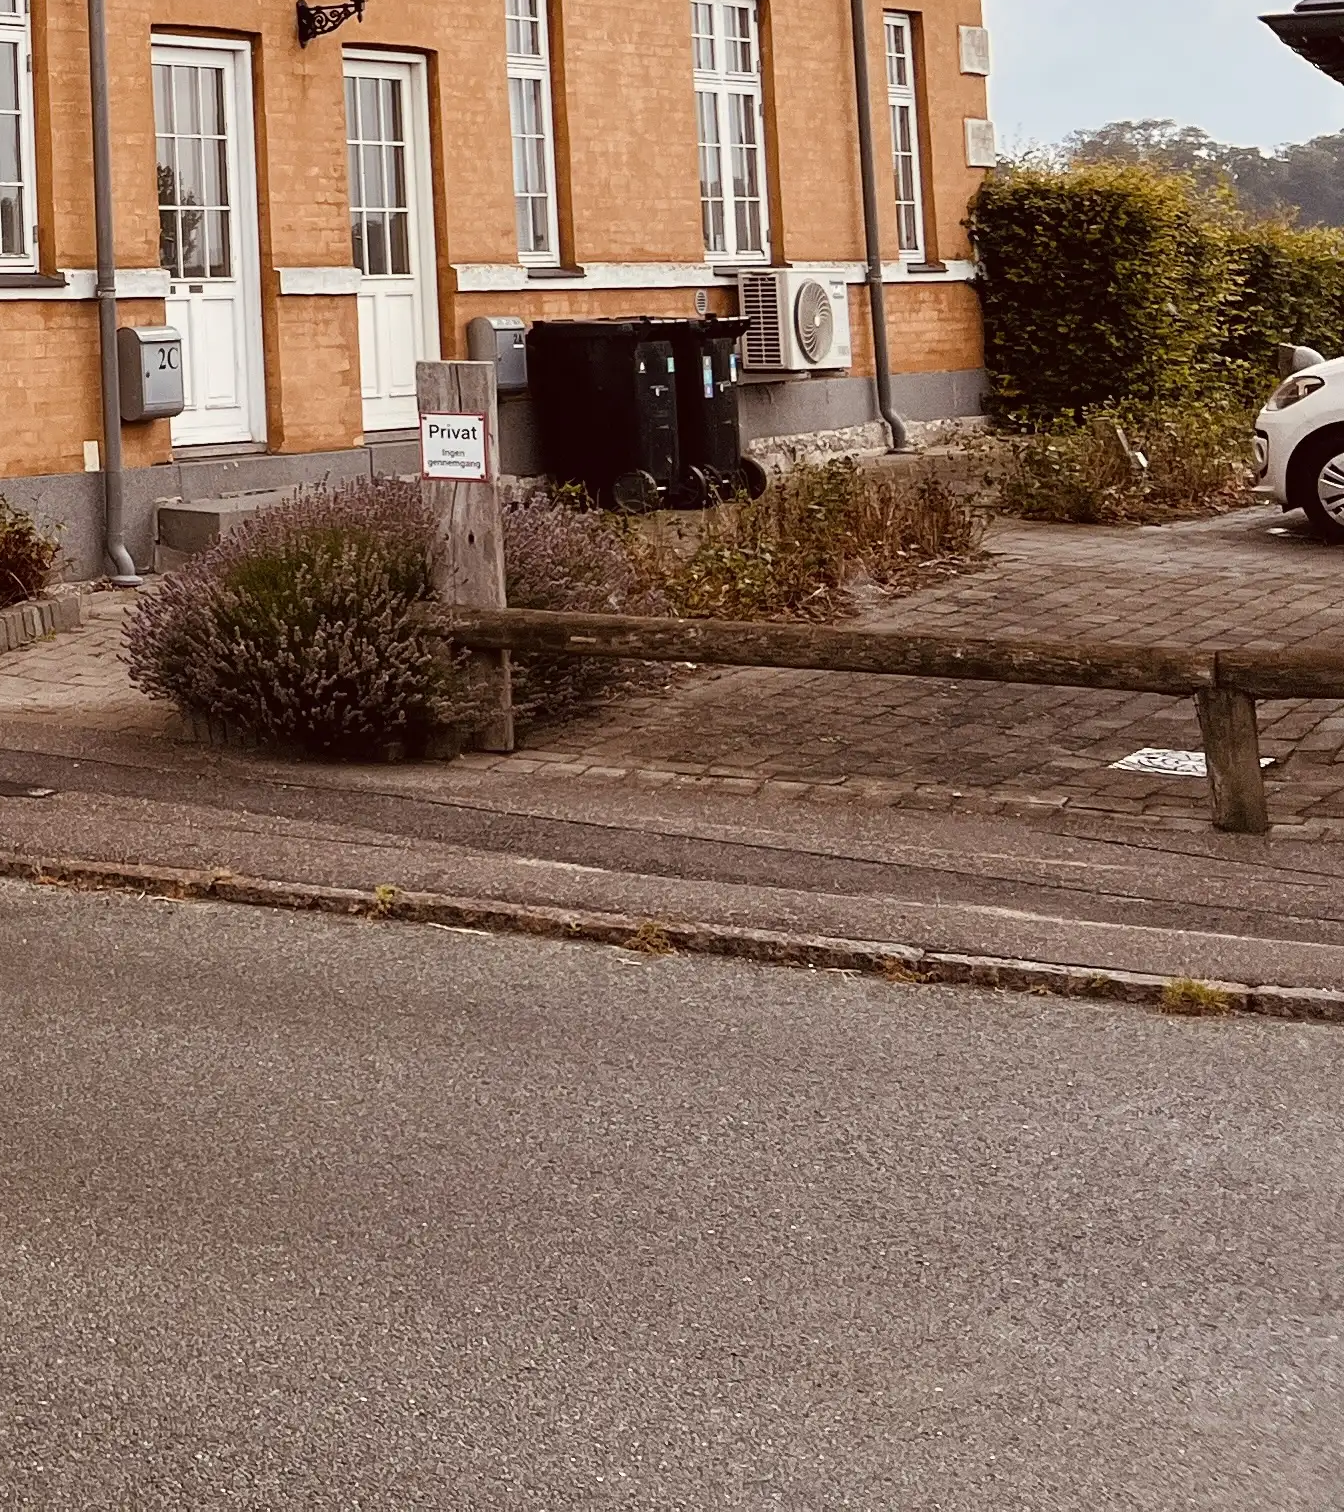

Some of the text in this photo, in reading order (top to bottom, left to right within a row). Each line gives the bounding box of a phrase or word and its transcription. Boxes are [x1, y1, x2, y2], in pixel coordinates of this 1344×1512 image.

[158, 347, 179, 370] 2C
[429, 424, 477, 440] Privat
[442, 449, 465, 458] Ingen
[427, 459, 481, 469] gennemgang
